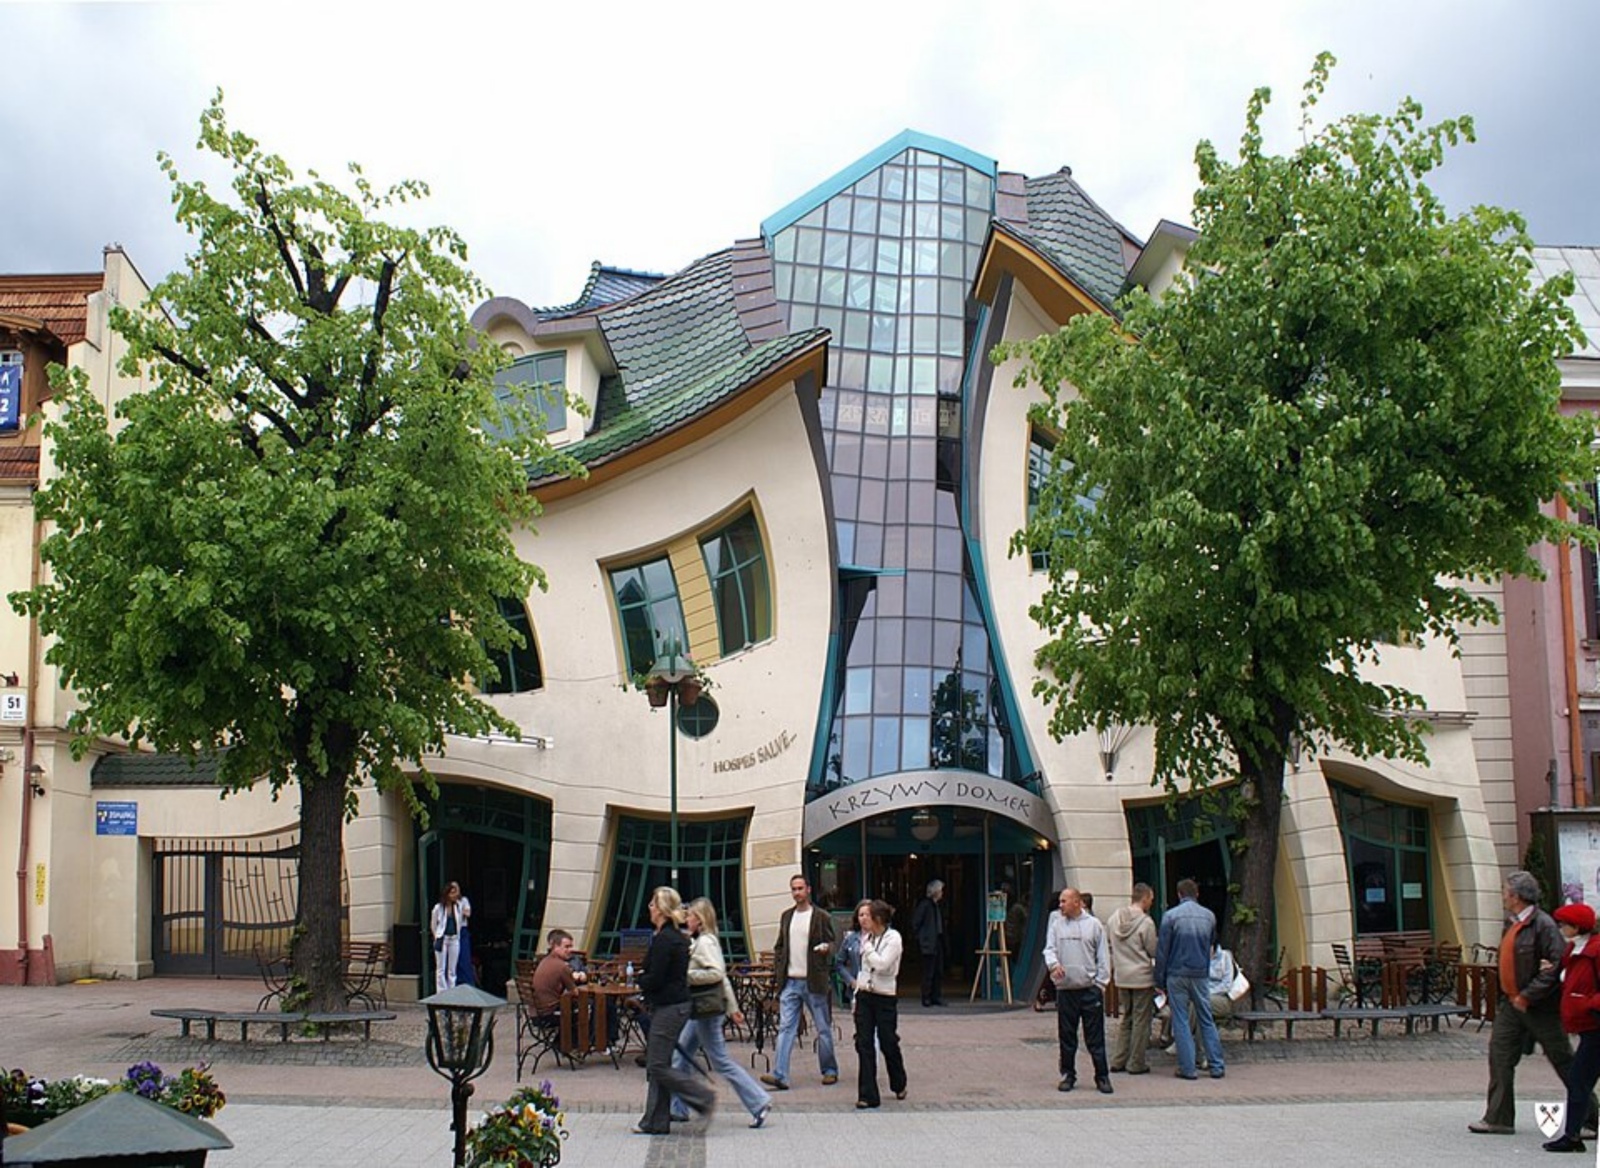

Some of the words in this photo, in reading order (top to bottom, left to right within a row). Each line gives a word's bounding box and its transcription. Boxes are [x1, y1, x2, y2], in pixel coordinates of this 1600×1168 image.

[8, 696, 20, 709] 51
[713, 752, 756, 774] HOSPES
[828, 780, 948, 820] KRZYWY
[956, 782, 1031, 818] DOMEK
